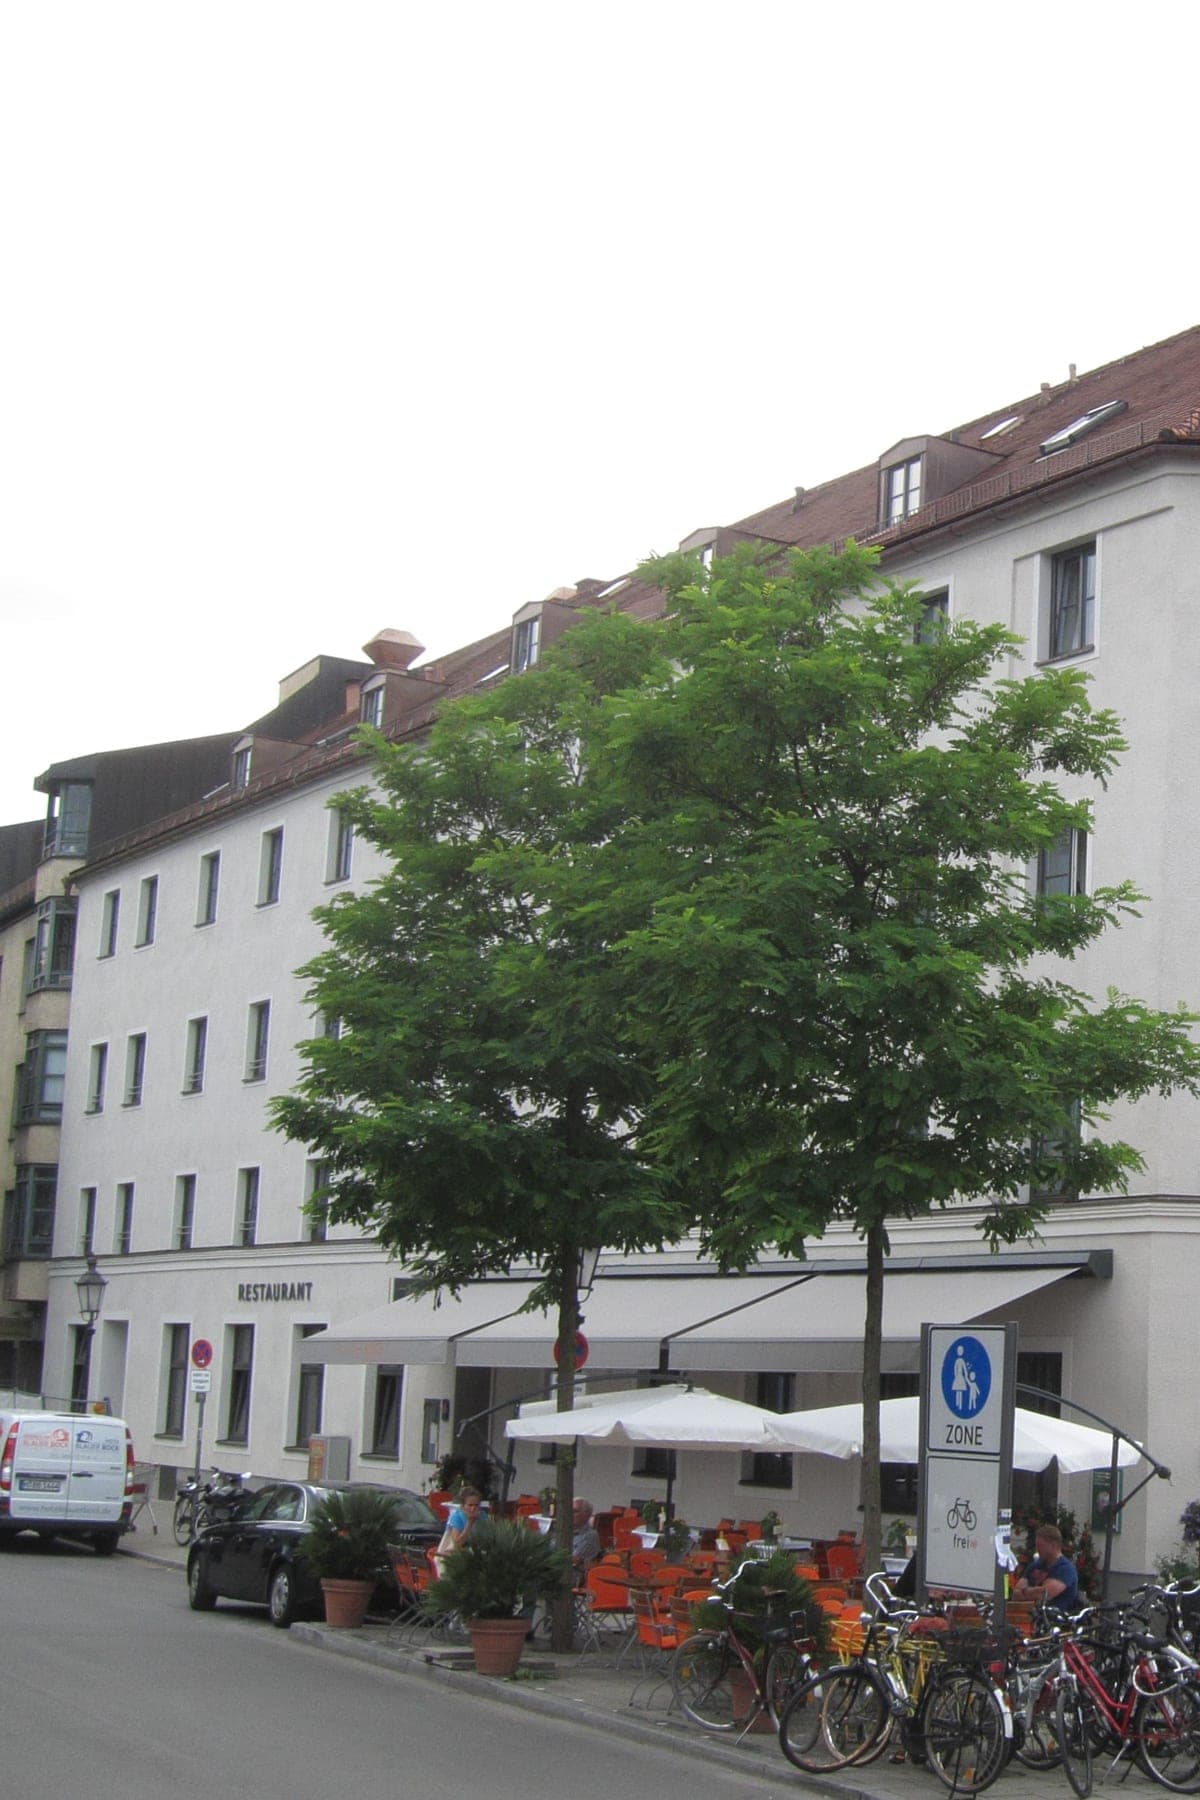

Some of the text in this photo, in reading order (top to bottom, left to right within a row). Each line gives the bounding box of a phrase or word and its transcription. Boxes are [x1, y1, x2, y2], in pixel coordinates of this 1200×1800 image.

[238, 1282, 313, 1302] RESTAURANT
[946, 1425, 983, 1445] ZONE
[953, 1534, 971, 1549] frei
